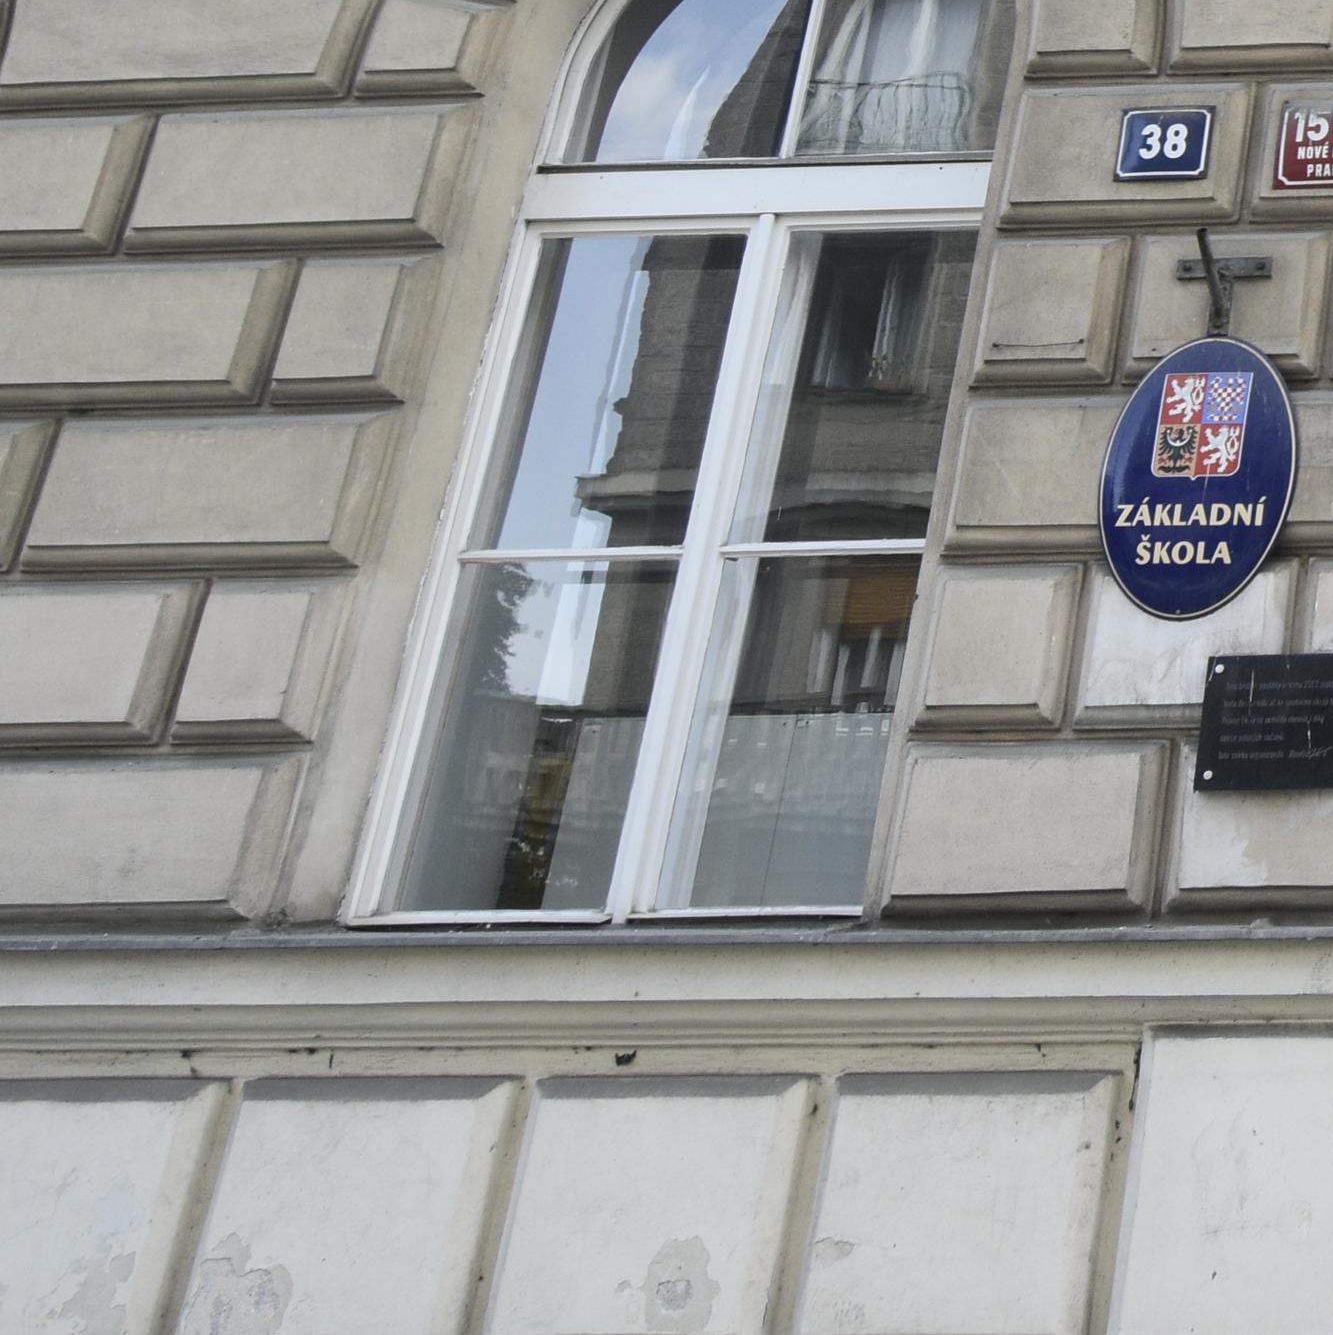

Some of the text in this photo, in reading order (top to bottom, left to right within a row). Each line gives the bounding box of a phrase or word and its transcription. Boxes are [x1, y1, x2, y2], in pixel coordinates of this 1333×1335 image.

[1138, 122, 1188, 160] 38
[1297, 143, 1329, 160] NOVÉ
[1114, 496, 1267, 527] ZÁKLADNÍ
[1135, 534, 1232, 565] ŠKOLA
